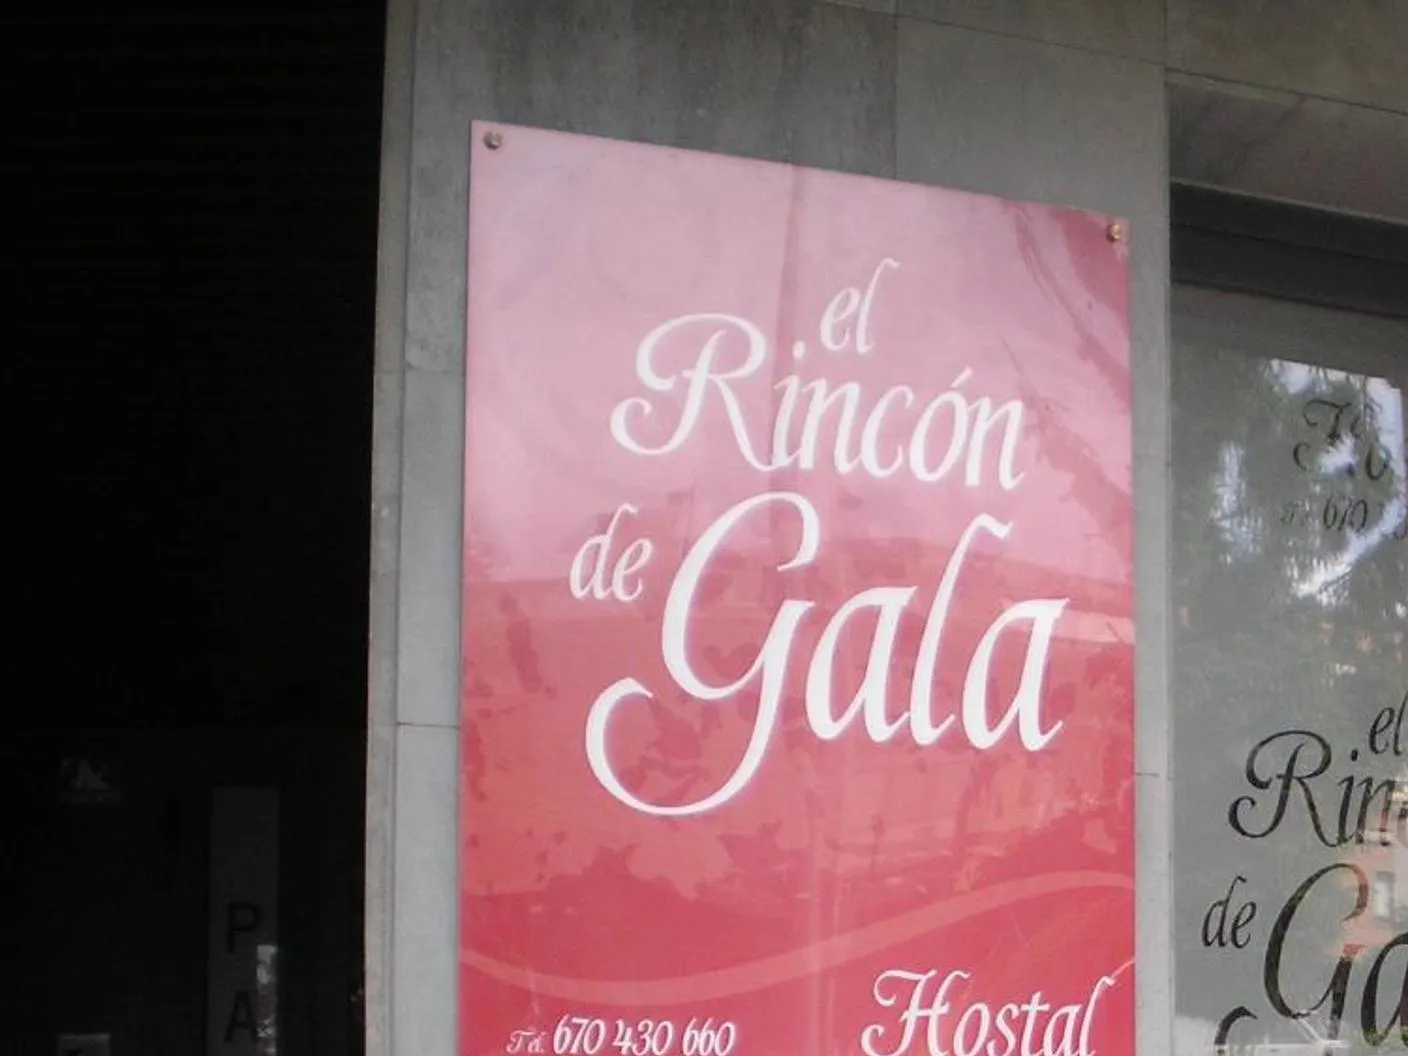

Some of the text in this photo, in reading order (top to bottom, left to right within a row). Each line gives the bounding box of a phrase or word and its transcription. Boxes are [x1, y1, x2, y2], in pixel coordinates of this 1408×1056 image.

[819, 257, 900, 355] el
[610, 311, 1026, 491] Rincón
[569, 492, 1071, 817] de Gala
[1201, 875, 1258, 950] de
